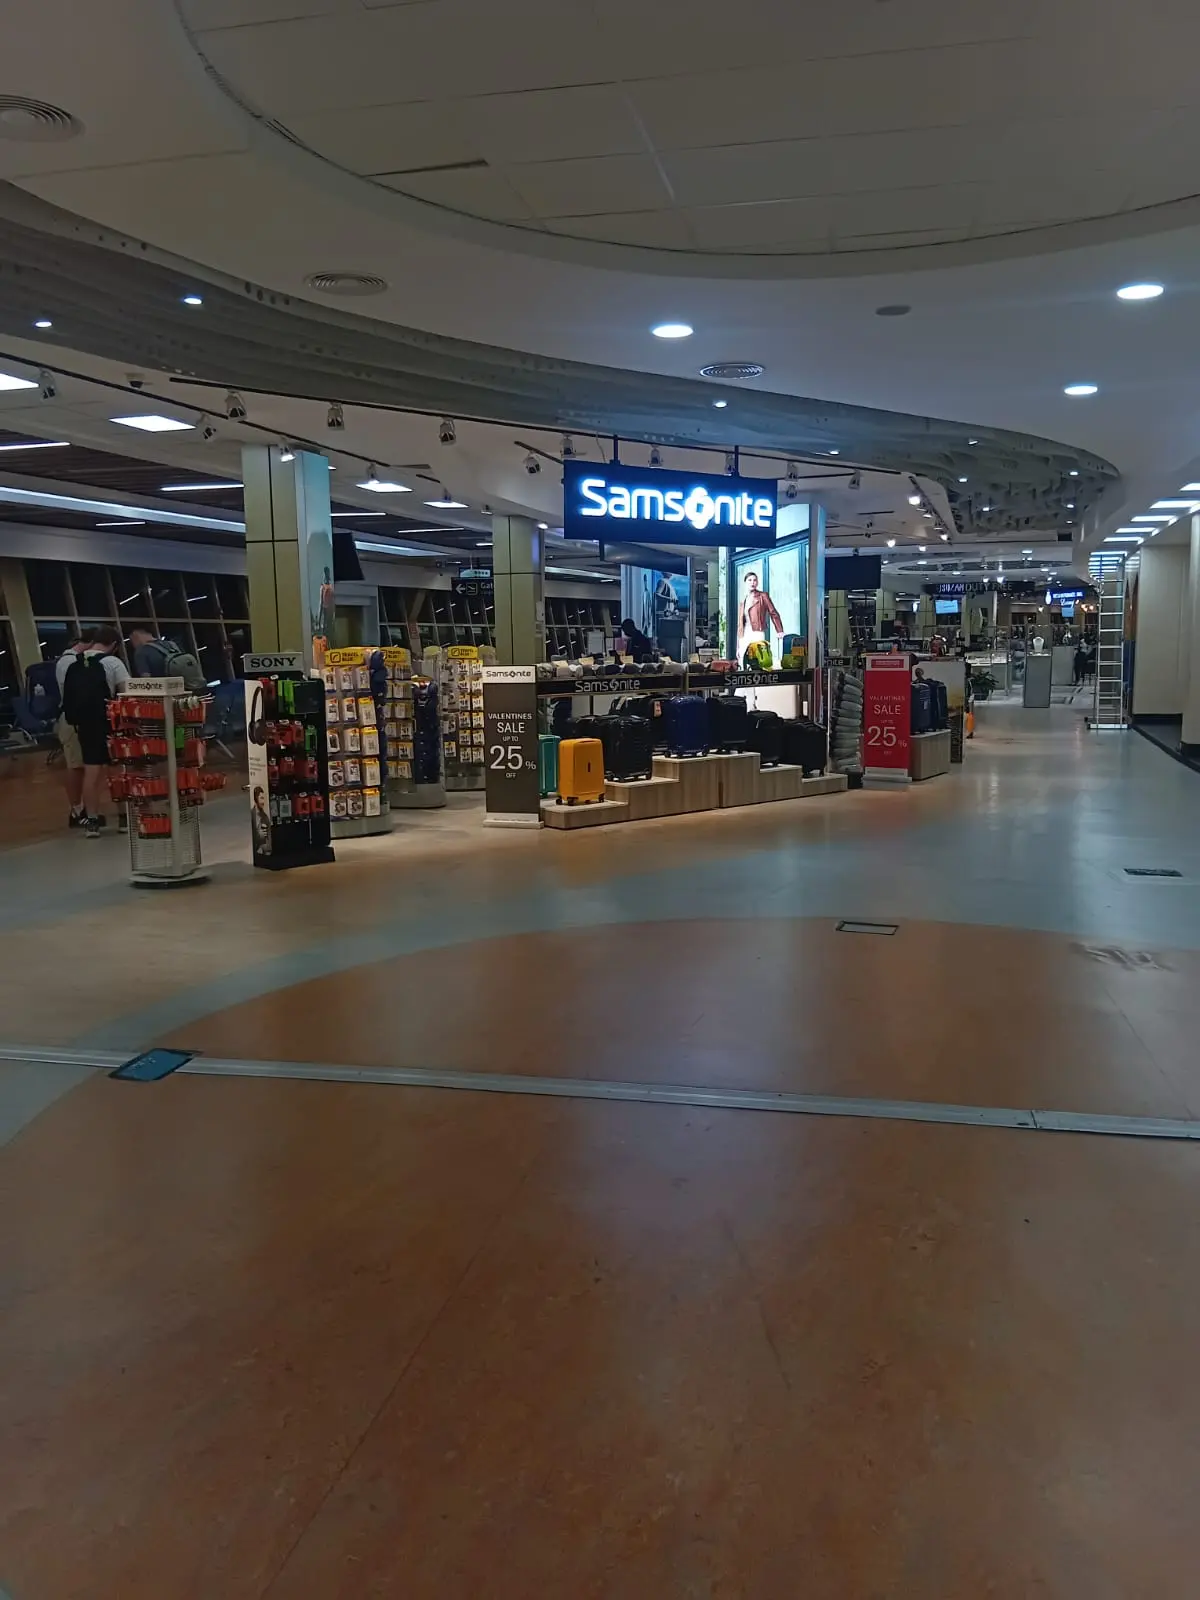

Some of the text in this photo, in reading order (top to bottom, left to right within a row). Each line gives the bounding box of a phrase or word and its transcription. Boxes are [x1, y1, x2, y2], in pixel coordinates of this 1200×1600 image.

[580, 477, 774, 530] Samsonite
[966, 583, 990, 593] DUTY
[250, 657, 296, 668] SONY
[486, 670, 532, 678] Samsonite
[724, 673, 780, 686] Samsonite
[128, 682, 163, 691] Samsonite
[575, 678, 641, 692] Samsonite
[874, 704, 901, 715] SALE
[488, 712, 533, 720] VALENTINES
[497, 721, 525, 733] SALE
